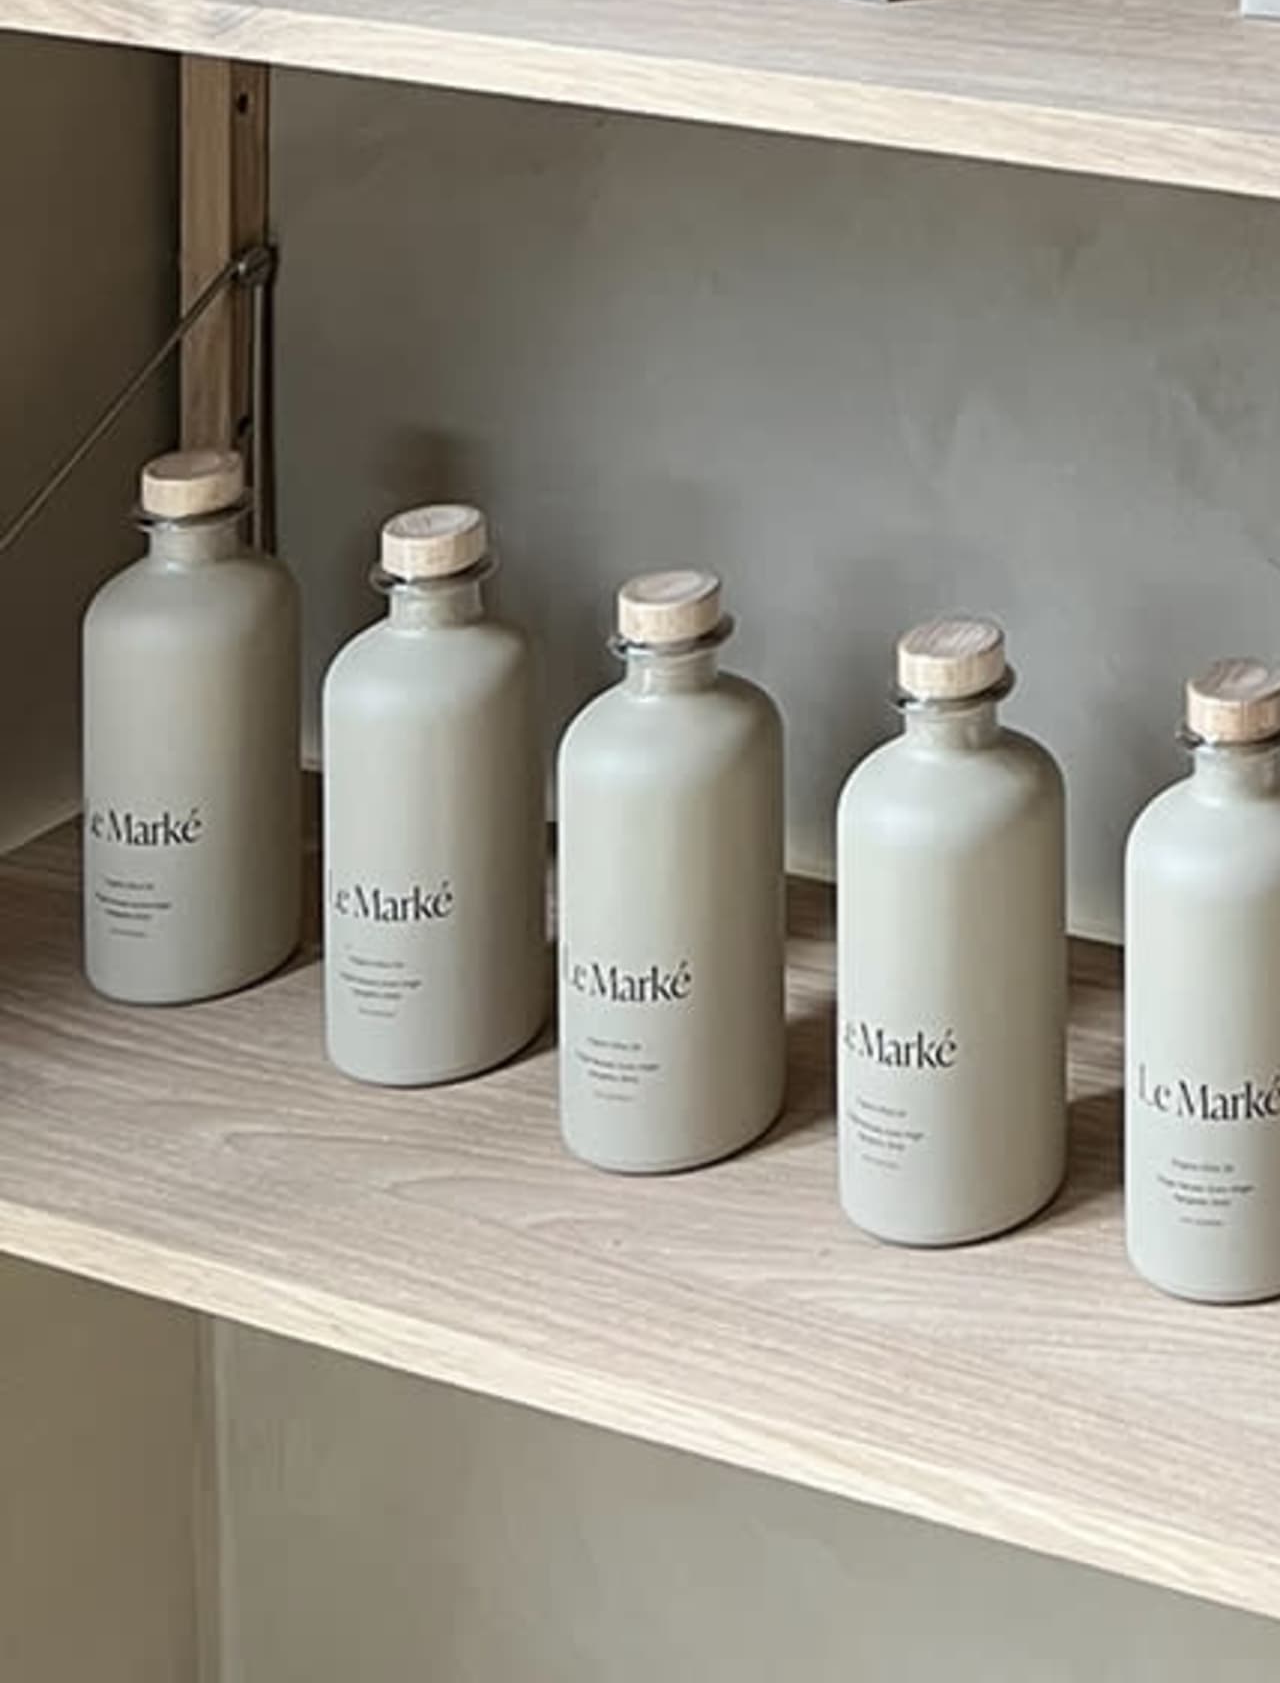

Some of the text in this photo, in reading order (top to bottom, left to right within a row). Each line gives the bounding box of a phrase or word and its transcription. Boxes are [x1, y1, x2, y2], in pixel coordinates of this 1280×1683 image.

[106, 807, 203, 846] Marké
[354, 880, 455, 923] Marké
[589, 959, 692, 1003] Marké
[858, 1022, 958, 1070] Marké
[1138, 1062, 1171, 1112] Le
